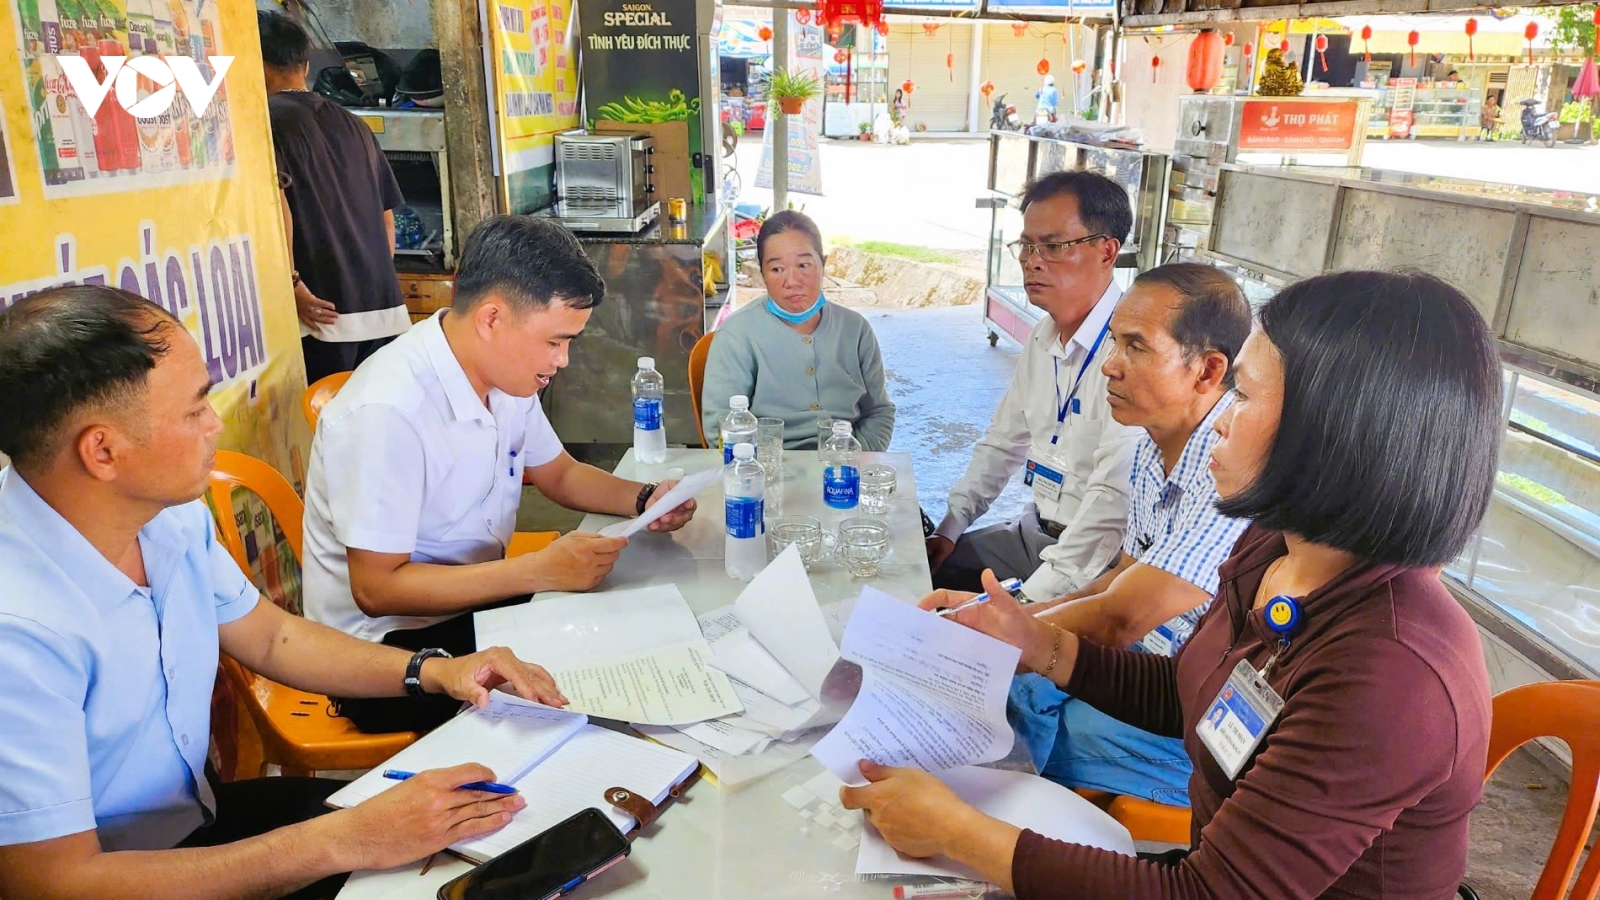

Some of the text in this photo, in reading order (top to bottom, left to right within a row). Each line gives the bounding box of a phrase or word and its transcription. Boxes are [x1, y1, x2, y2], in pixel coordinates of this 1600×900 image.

[60, 15, 77, 28] fuze
[82, 15, 97, 28] fuze
[100, 14, 115, 28] fuze
[604, 12, 672, 26] SPECIAL
[24, 28, 38, 40] fuze
[588, 32, 691, 52] TÌNH YÊU ĐÍCH THỰC
[1283, 111, 1339, 127] THỌ PHÁT
[192, 239, 266, 399] LOẠI
[826, 485, 854, 495] AQUAFINA
